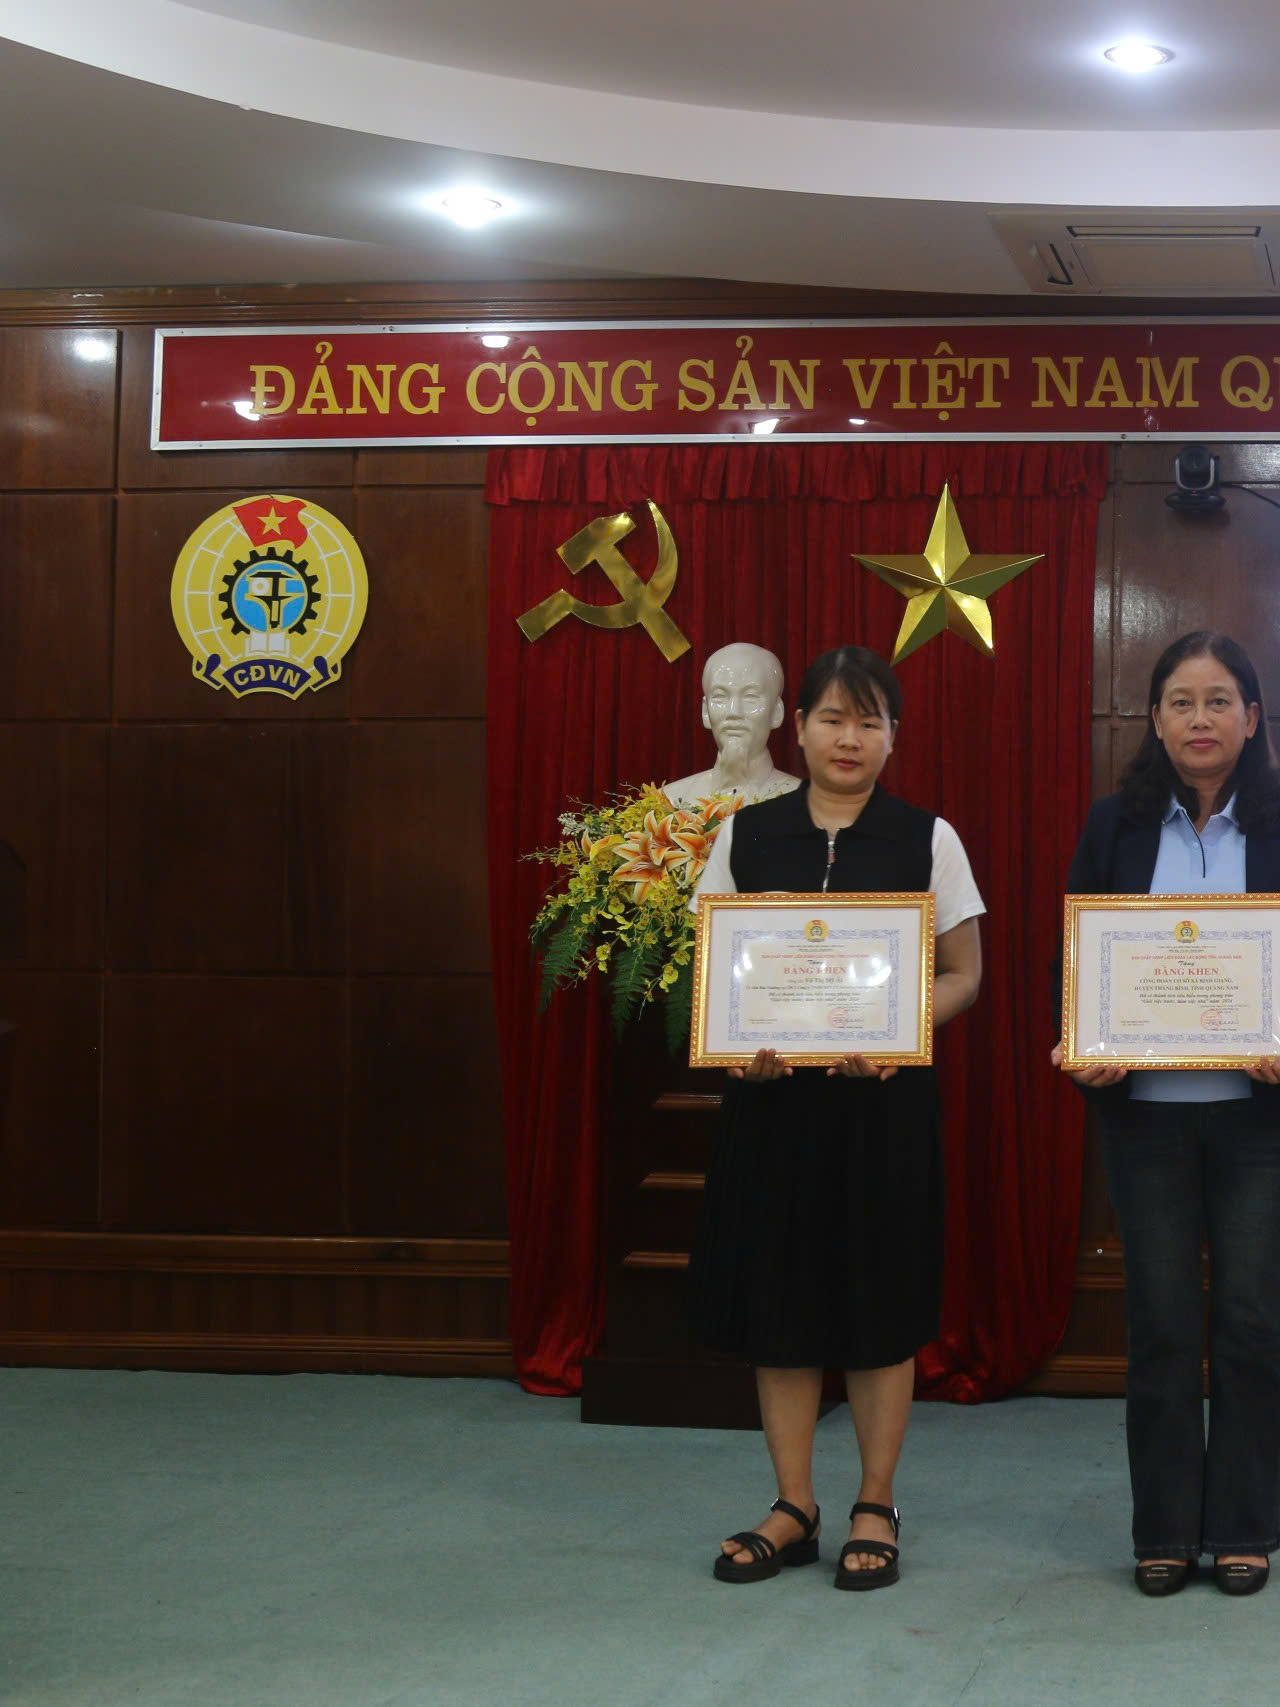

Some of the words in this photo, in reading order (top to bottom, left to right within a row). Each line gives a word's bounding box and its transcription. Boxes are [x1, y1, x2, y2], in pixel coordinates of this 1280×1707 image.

[249, 341, 446, 415] ĐẢNG
[465, 346, 660, 427] CỘNG
[677, 337, 821, 412] SẢN
[843, 342, 1010, 421] VIỆT
[1031, 357, 1199, 408] NAM
[232, 664, 301, 688] CĐVN
